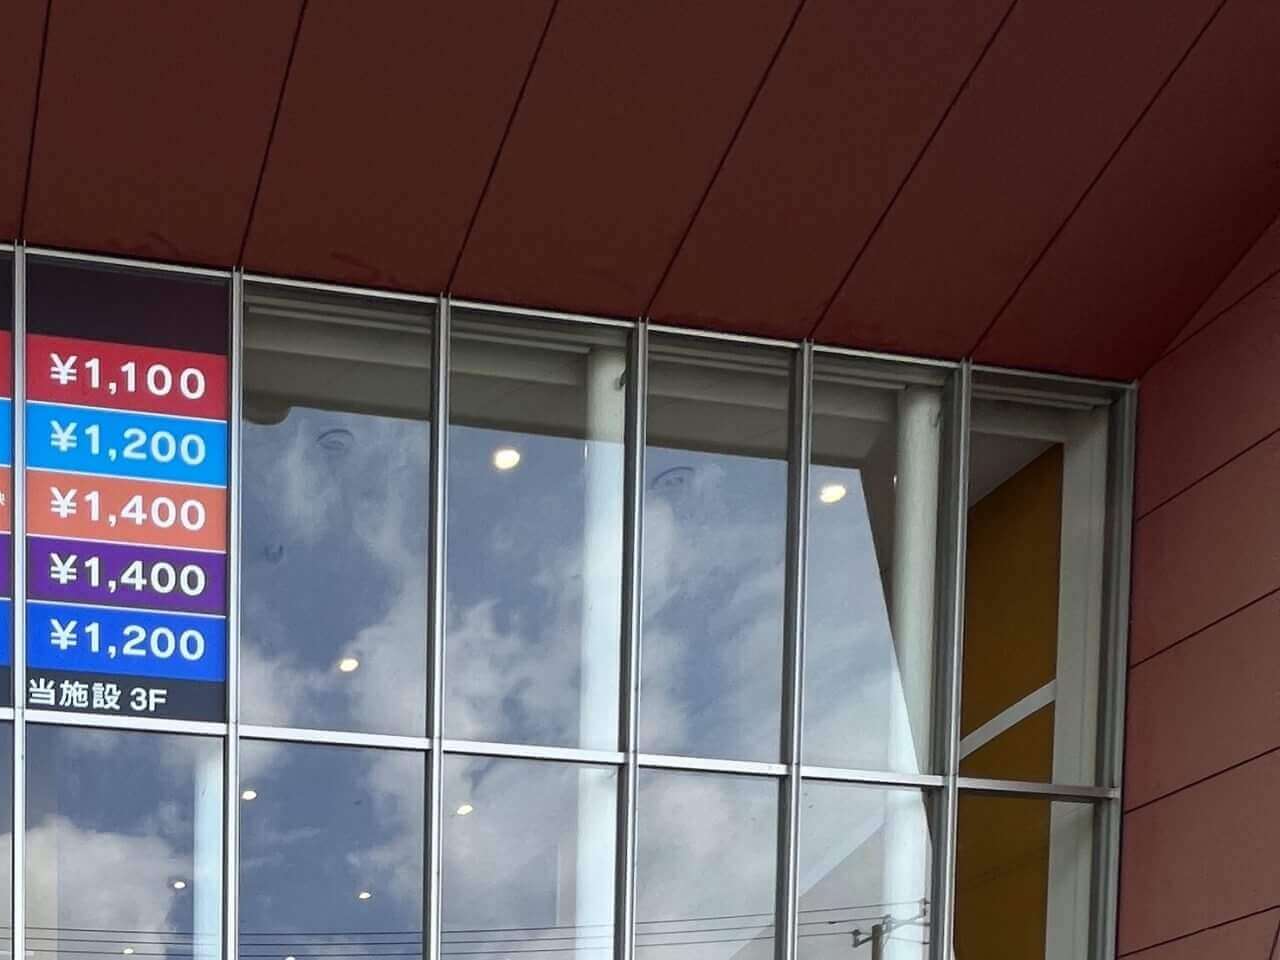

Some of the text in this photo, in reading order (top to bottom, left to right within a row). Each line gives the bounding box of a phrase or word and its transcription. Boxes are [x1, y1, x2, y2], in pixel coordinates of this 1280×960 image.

[50, 353, 207, 401] ¥1,100
[50, 420, 207, 467] ¥1,200
[50, 487, 207, 533] ¥1,400
[50, 552, 207, 598] ¥1,400
[50, 619, 207, 662] ¥1,200
